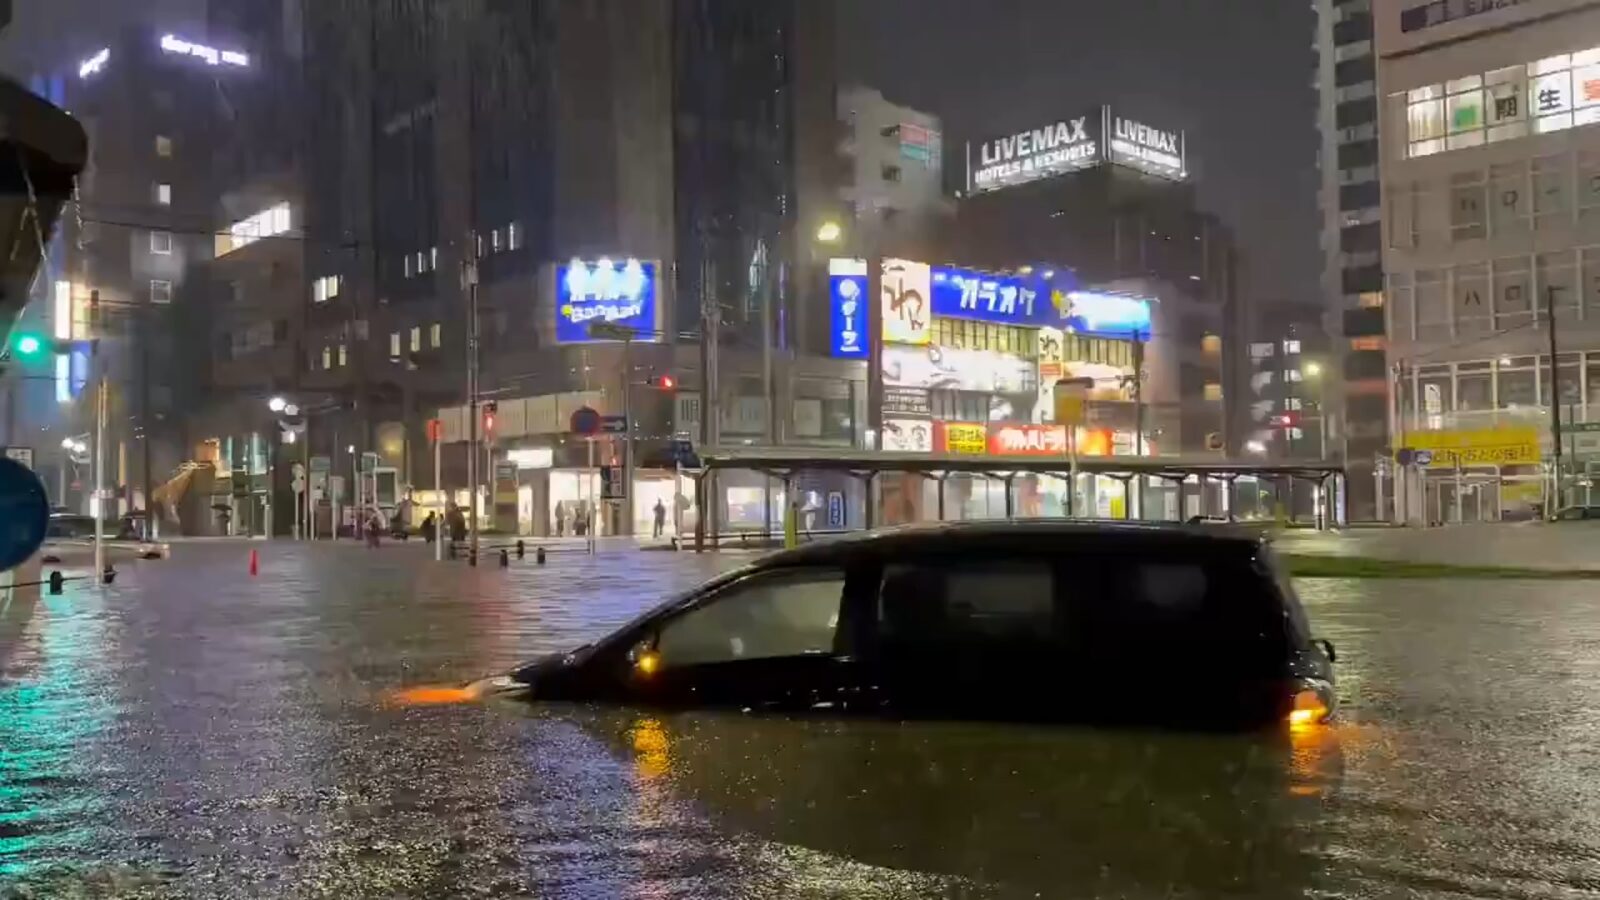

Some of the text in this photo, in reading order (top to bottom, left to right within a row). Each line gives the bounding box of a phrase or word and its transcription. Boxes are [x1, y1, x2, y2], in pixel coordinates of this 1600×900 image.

[975, 161, 1021, 184] HOTELS
[960, 277, 1036, 317] カラオケ
